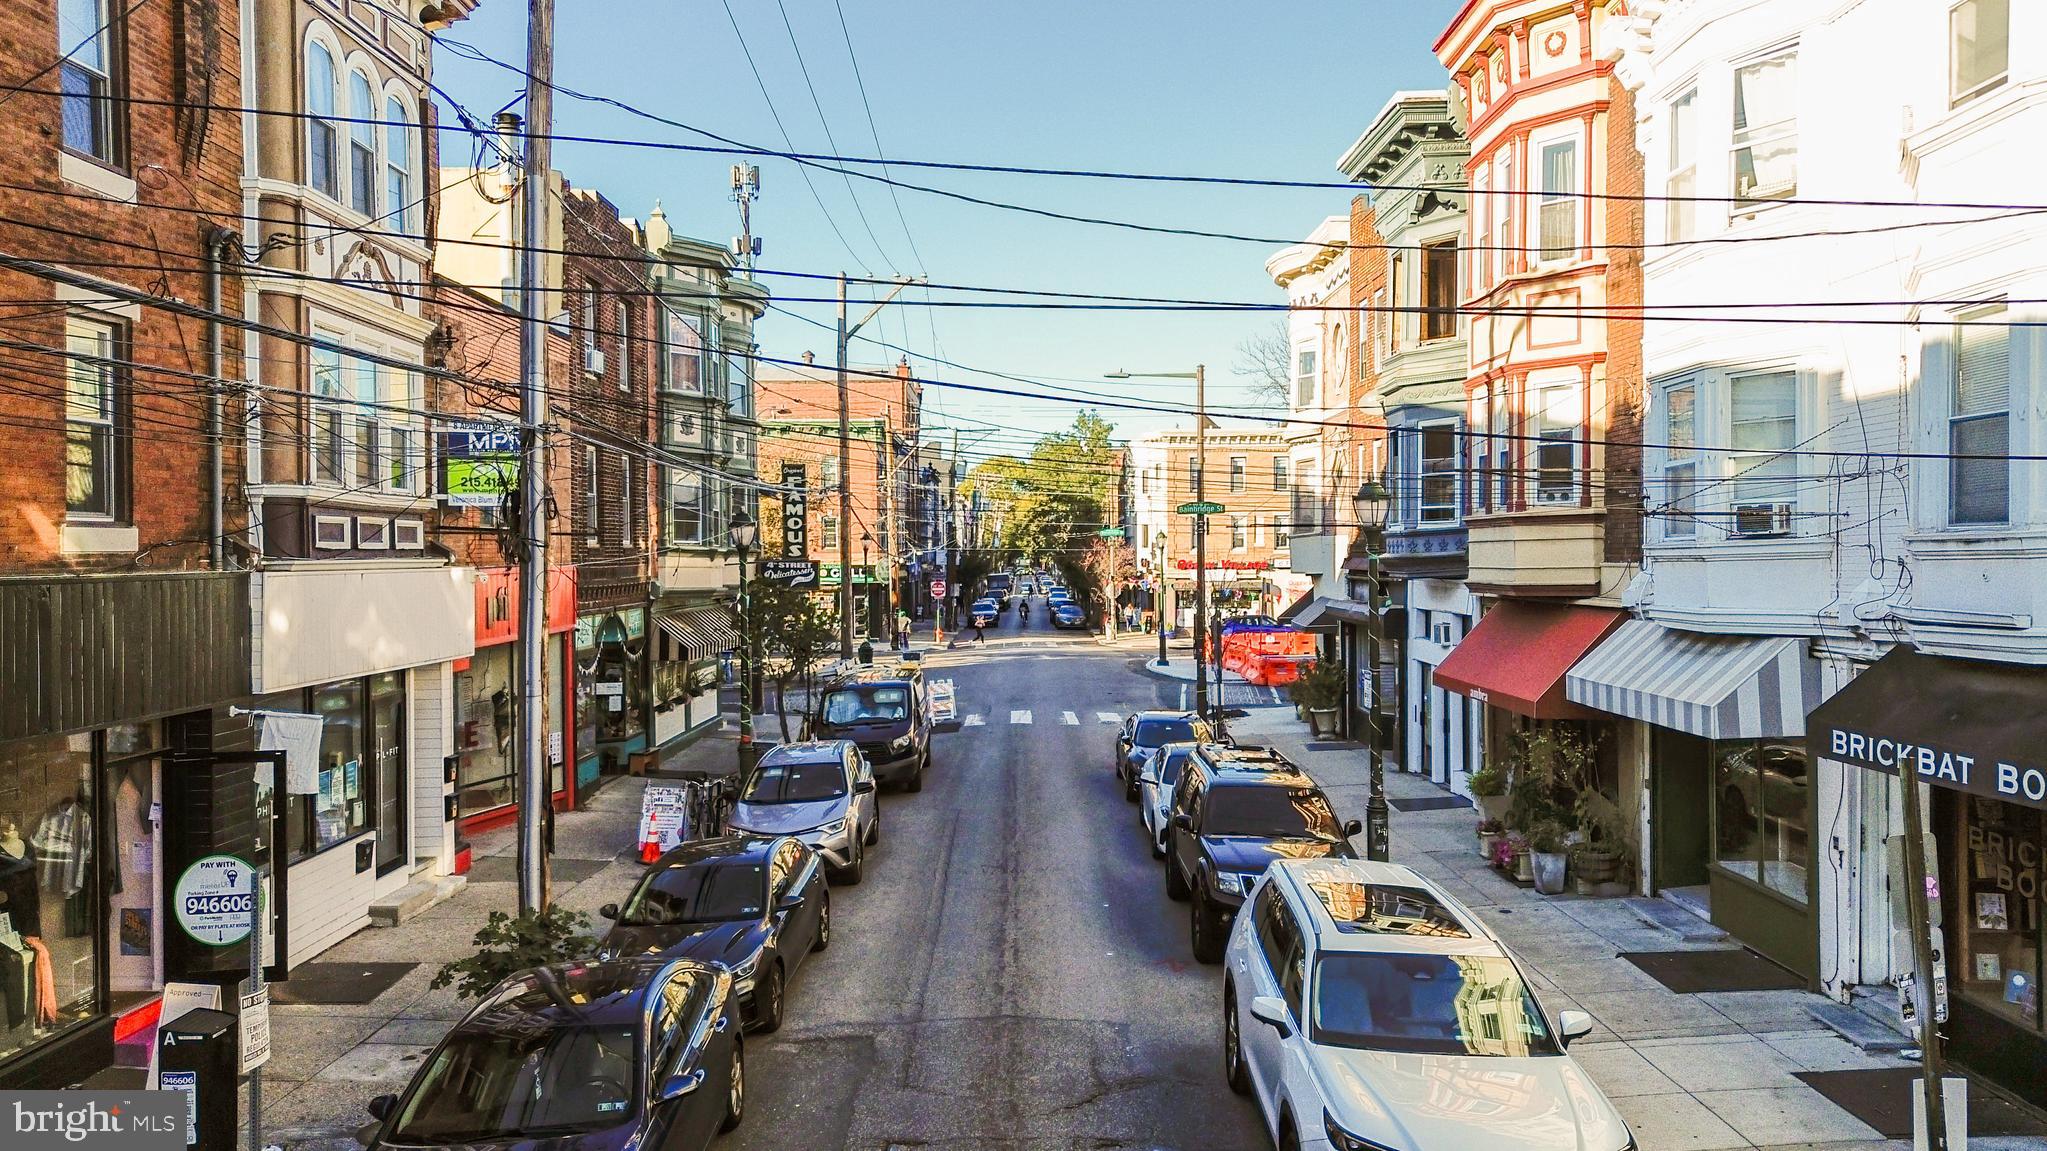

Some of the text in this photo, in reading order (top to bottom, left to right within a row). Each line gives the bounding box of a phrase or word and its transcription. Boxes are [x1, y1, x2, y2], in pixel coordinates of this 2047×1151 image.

[1179, 505, 1214, 513] Bainbridge
[786, 477, 803, 556] FAMOUS
[764, 568, 813, 579] Delicatessen
[1832, 729, 1974, 784] BRICKBAT
[187, 895, 251, 914] 946606
[169, 989, 202, 997] Approved
[243, 997, 251, 1008] NO
[164, 1032, 176, 1046] A
[163, 1075, 194, 1084] 946606
